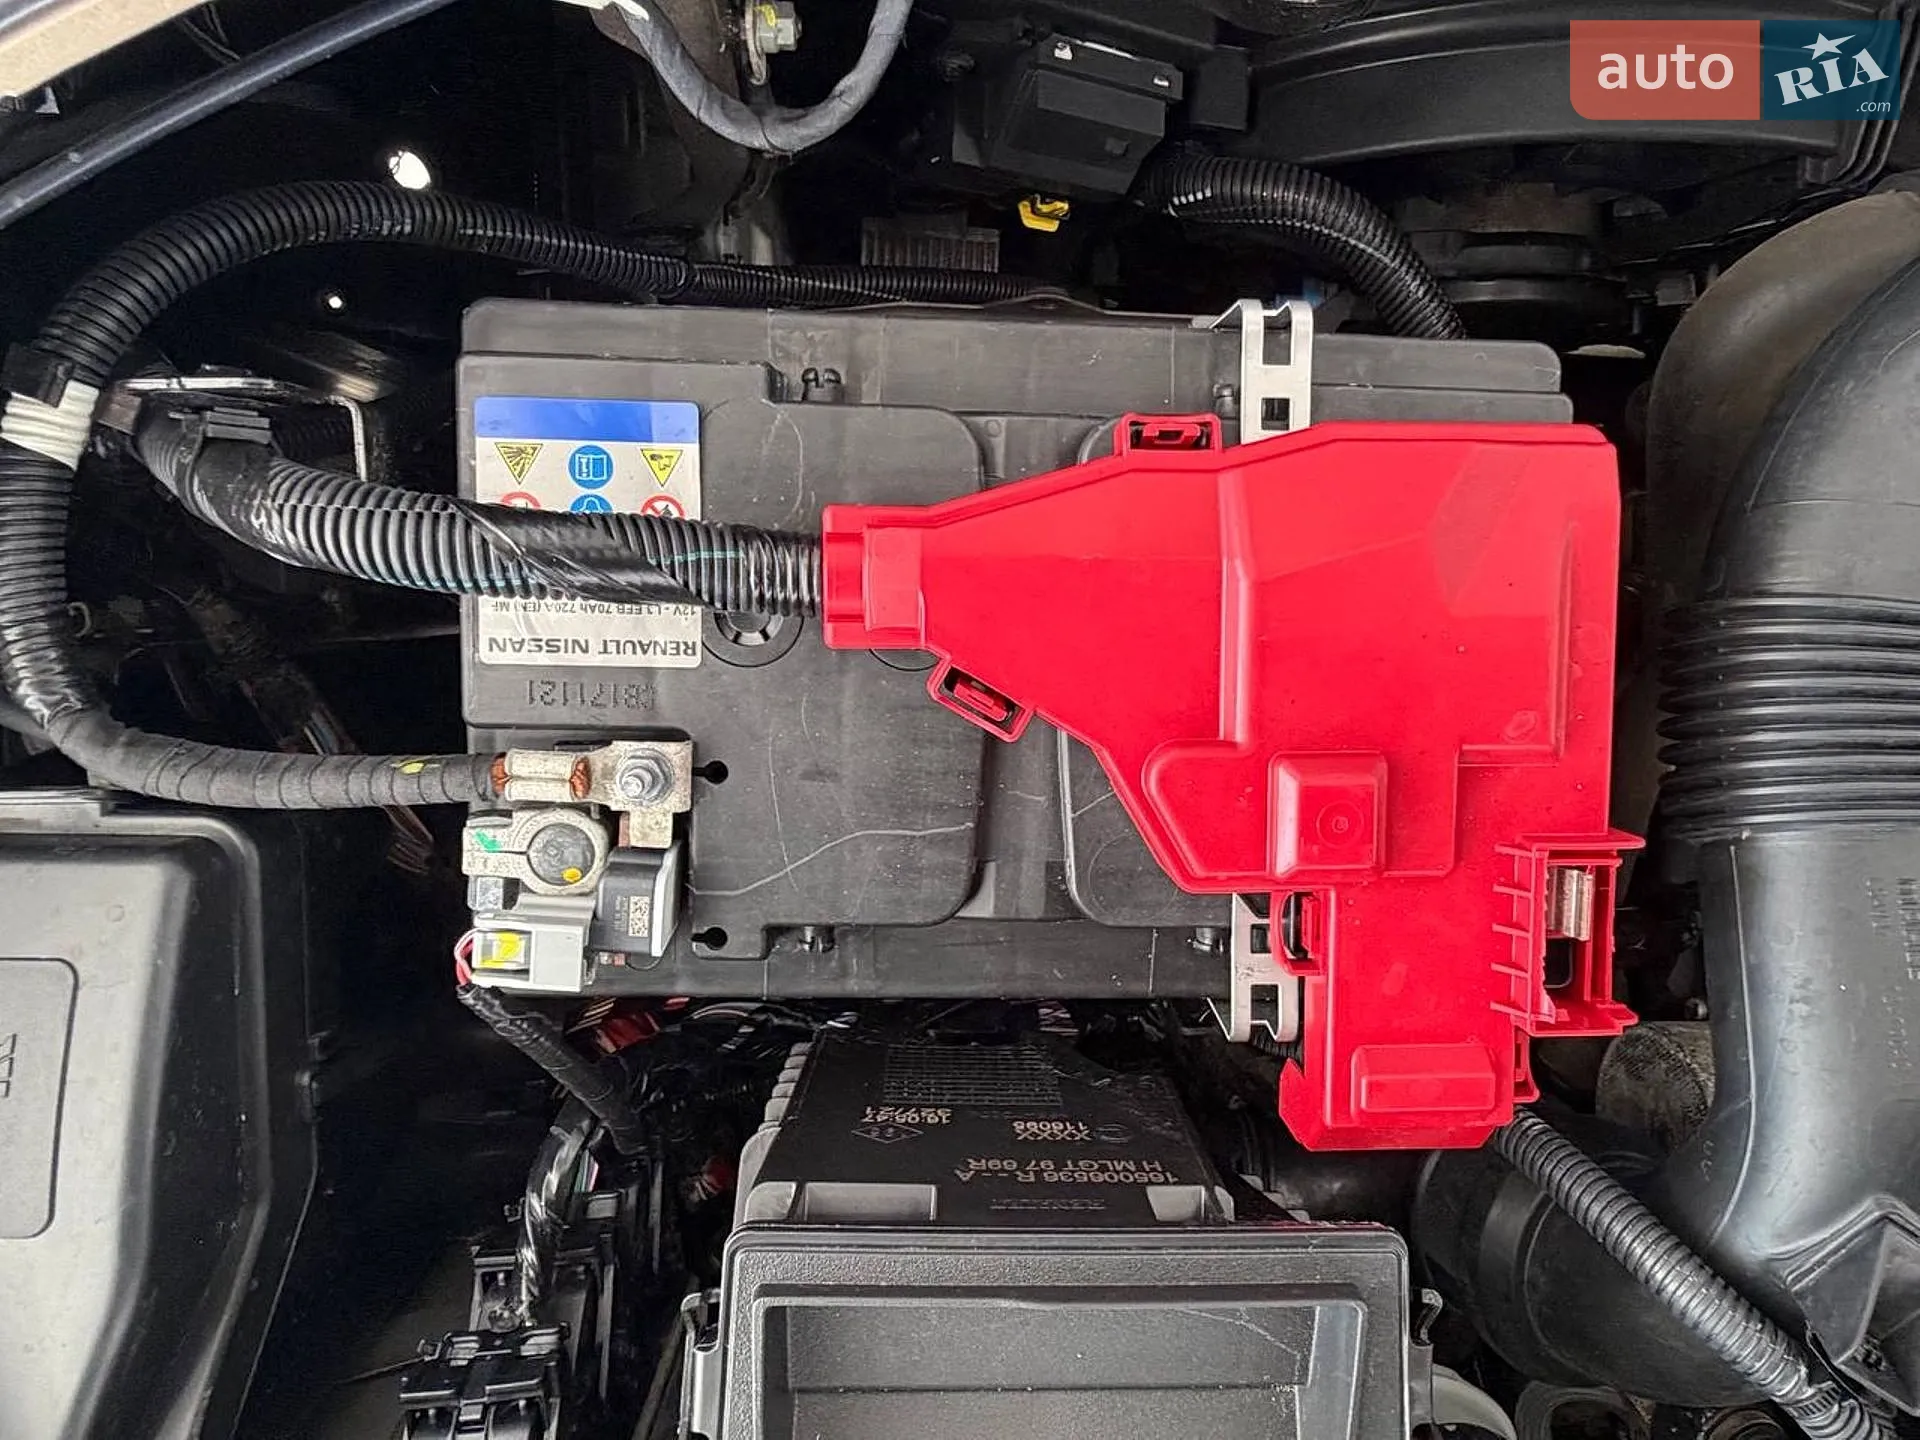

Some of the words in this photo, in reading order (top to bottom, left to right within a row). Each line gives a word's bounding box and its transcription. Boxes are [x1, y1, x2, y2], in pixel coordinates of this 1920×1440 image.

[580, 602, 612, 614] 70Ah
[488, 637, 590, 654] NISSAN
[599, 639, 698, 656] RENAULT
